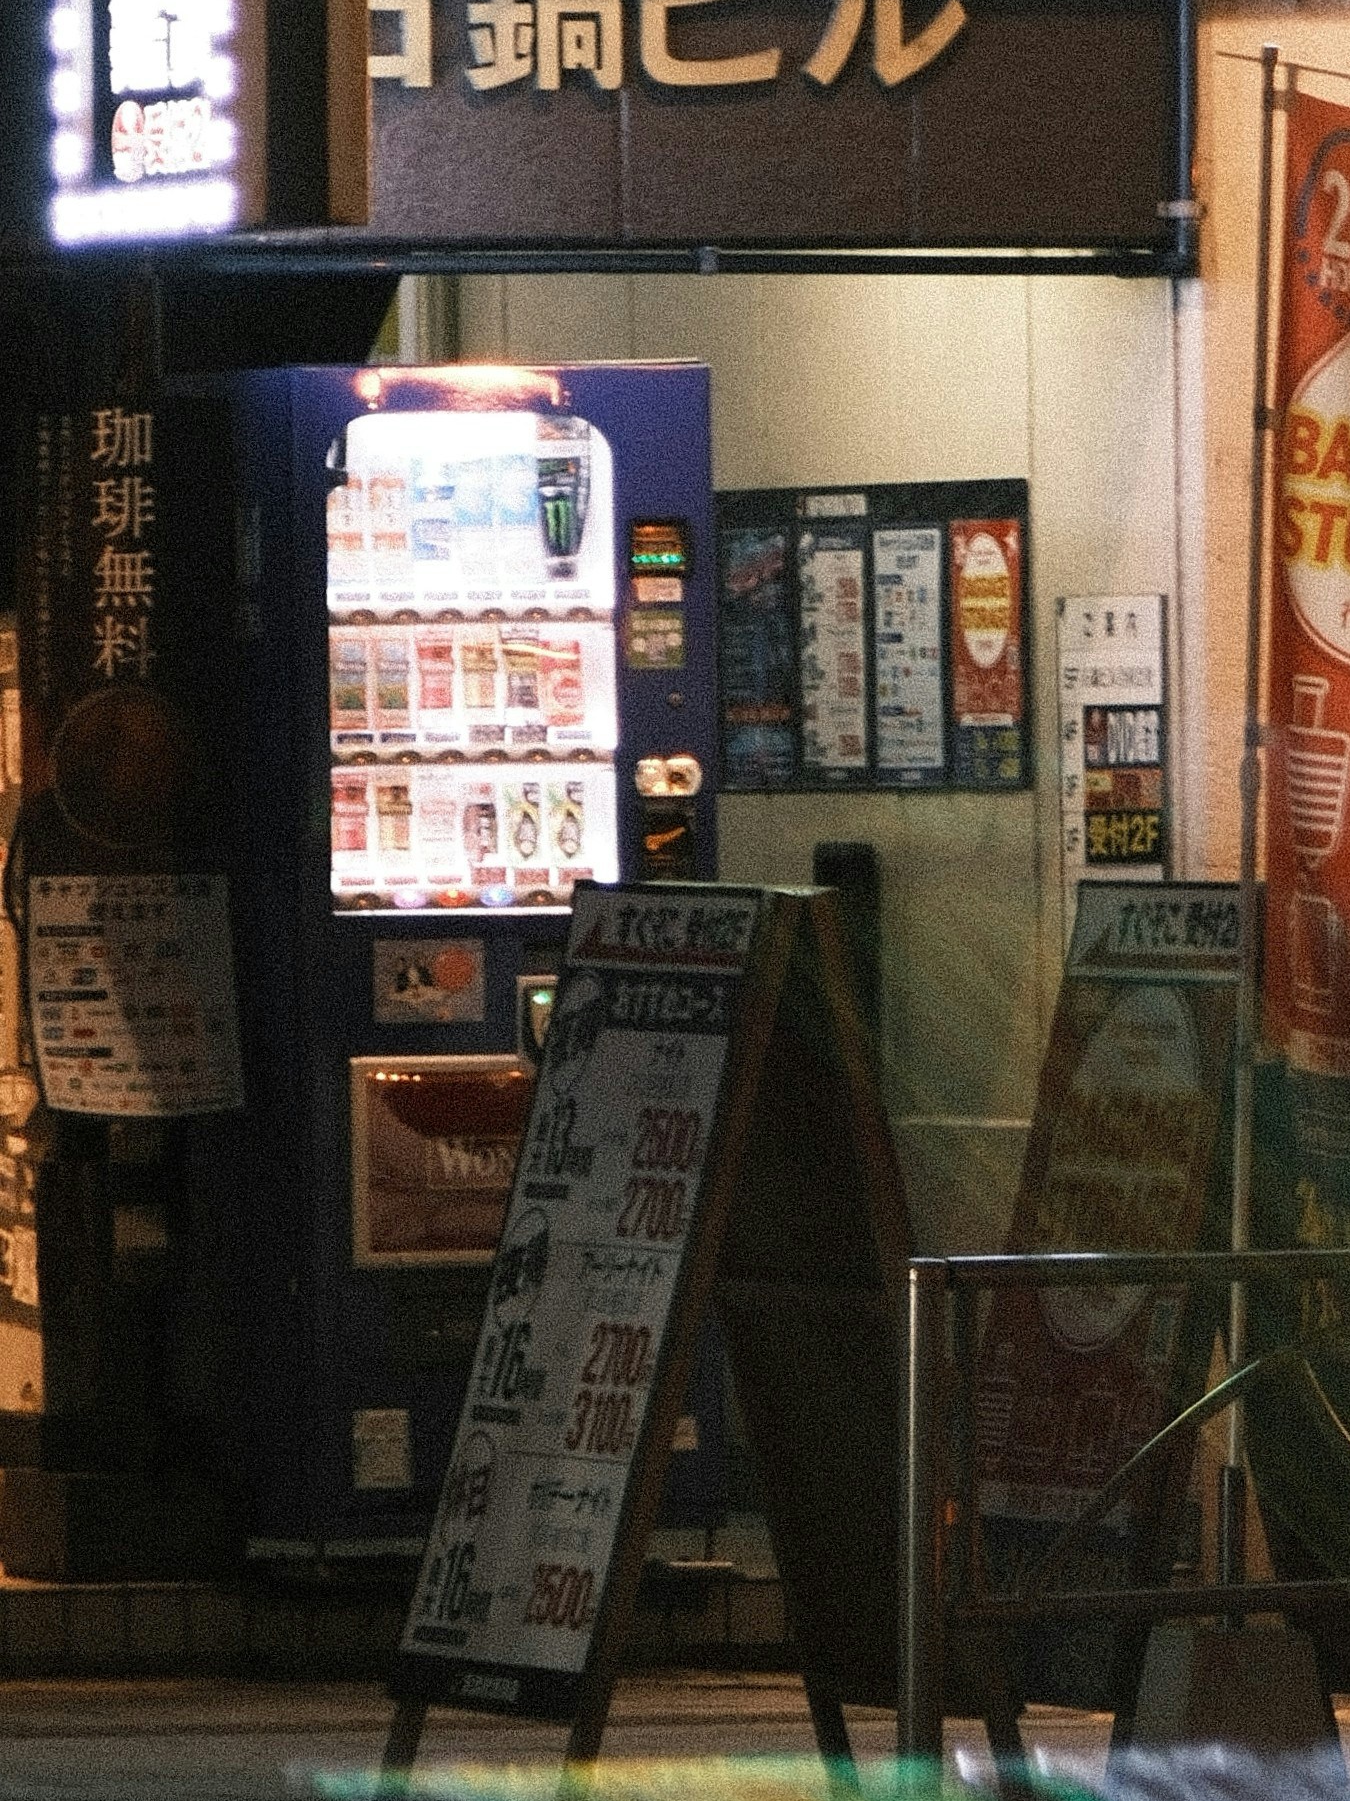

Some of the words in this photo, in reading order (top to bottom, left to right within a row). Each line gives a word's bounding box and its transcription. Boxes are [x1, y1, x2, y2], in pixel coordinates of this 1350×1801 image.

[89, 406, 157, 679] 珈琲無料
[1087, 814, 1161, 858] 受付2F
[1185, 899, 1239, 949] 受付2
